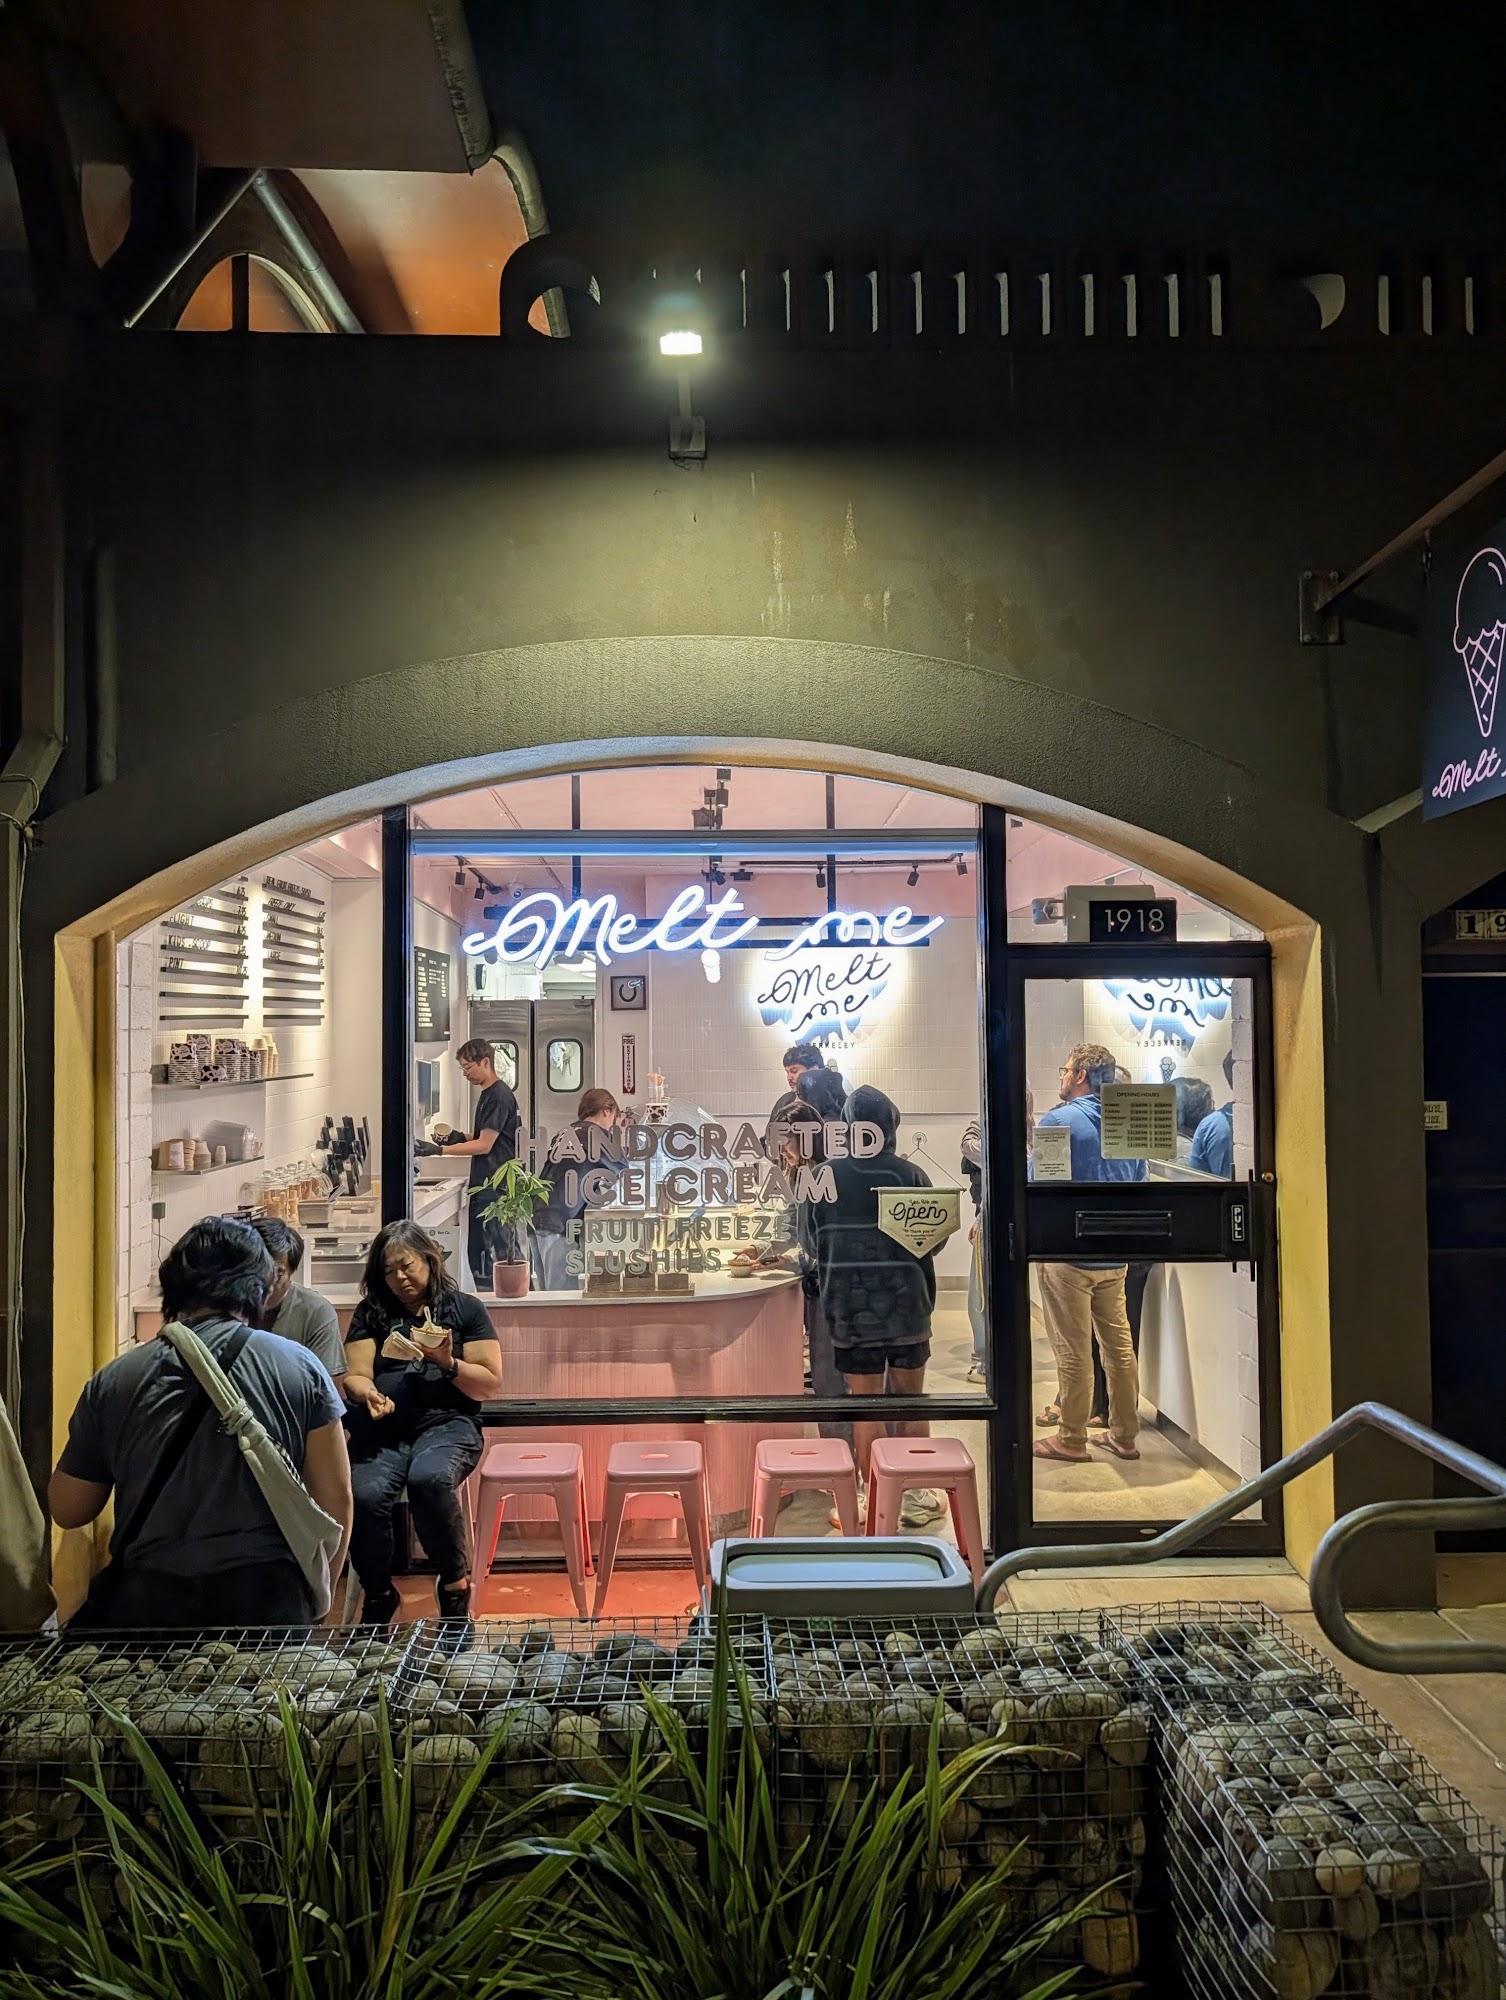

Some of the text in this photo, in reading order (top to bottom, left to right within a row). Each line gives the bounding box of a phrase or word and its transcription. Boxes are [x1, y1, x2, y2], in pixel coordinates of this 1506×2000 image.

[1432, 747, 1501, 799] Melt
[462, 885, 946, 971] Melt me
[1104, 908, 1165, 933] 1918
[757, 951, 892, 1004] Melt
[790, 994, 870, 1033] me
[515, 1120, 885, 1165] HANDCRAFTED
[564, 1165, 838, 1208] ICE CREAM
[566, 1215, 792, 1244] FRUIT FREEZE
[888, 1202, 948, 1228] Open
[1233, 1207, 1242, 1239] PULL
[565, 1247, 722, 1276] SLUSHIES
